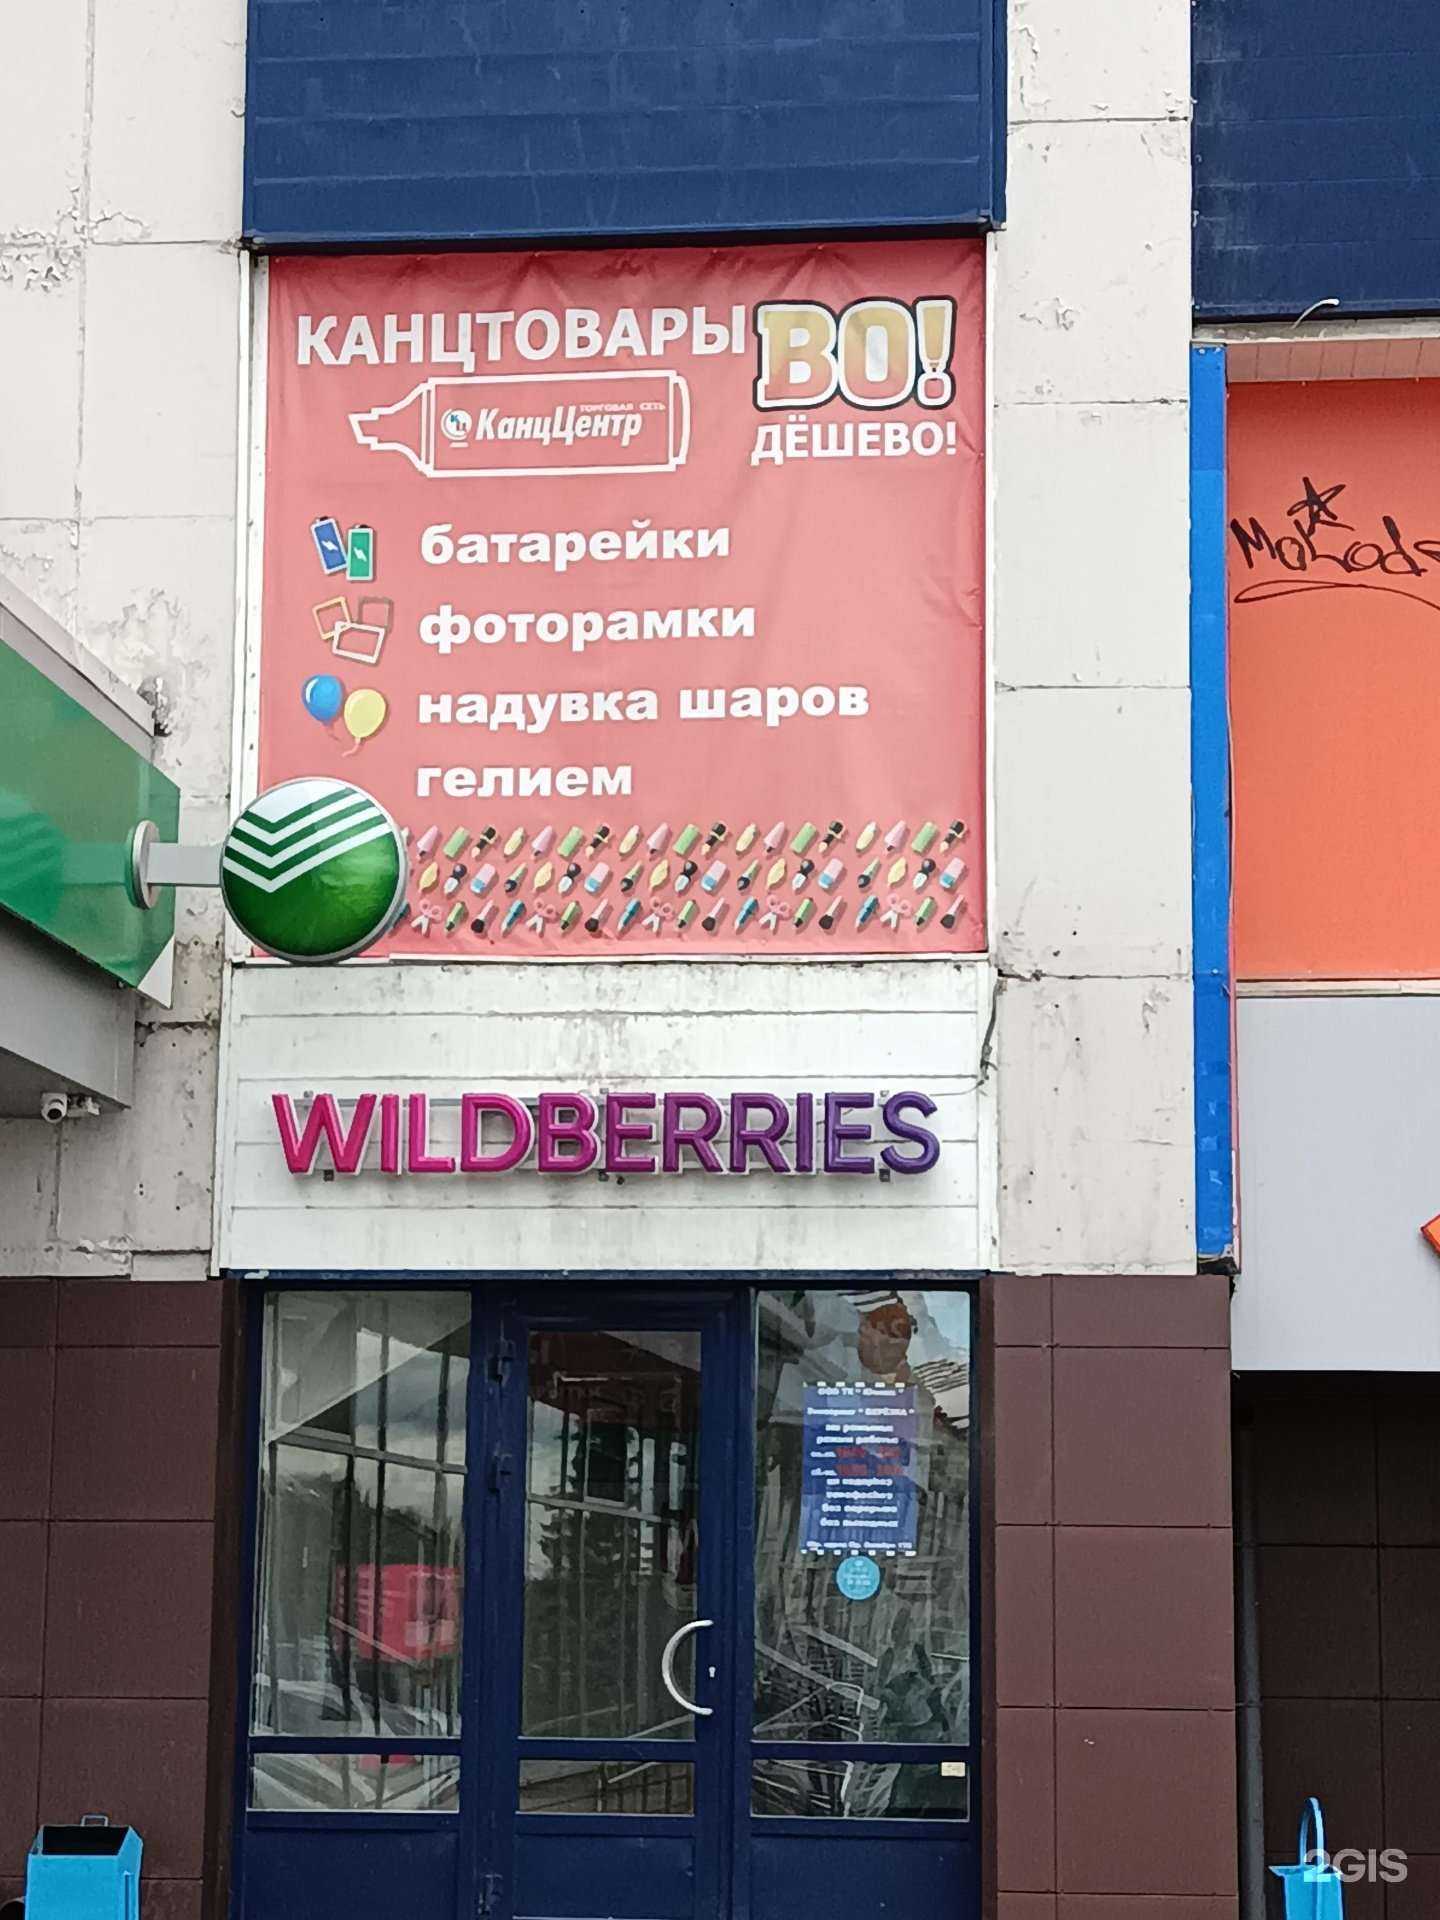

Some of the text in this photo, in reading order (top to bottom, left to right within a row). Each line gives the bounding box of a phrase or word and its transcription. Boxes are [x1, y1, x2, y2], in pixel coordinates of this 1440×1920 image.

[297, 306, 746, 372] КАНЦТОВАРЫ
[753, 296, 957, 412] ВО!
[475, 405, 643, 447] КанцЦентр
[751, 414, 957, 466] ДЁШЕВО!
[420, 518, 730, 572] батарейки
[419, 604, 756, 654] фоторамки
[418, 684, 870, 734] надувка шаров
[416, 765, 633, 798] гелием
[271, 1091, 942, 1176] WILDBERRIES
